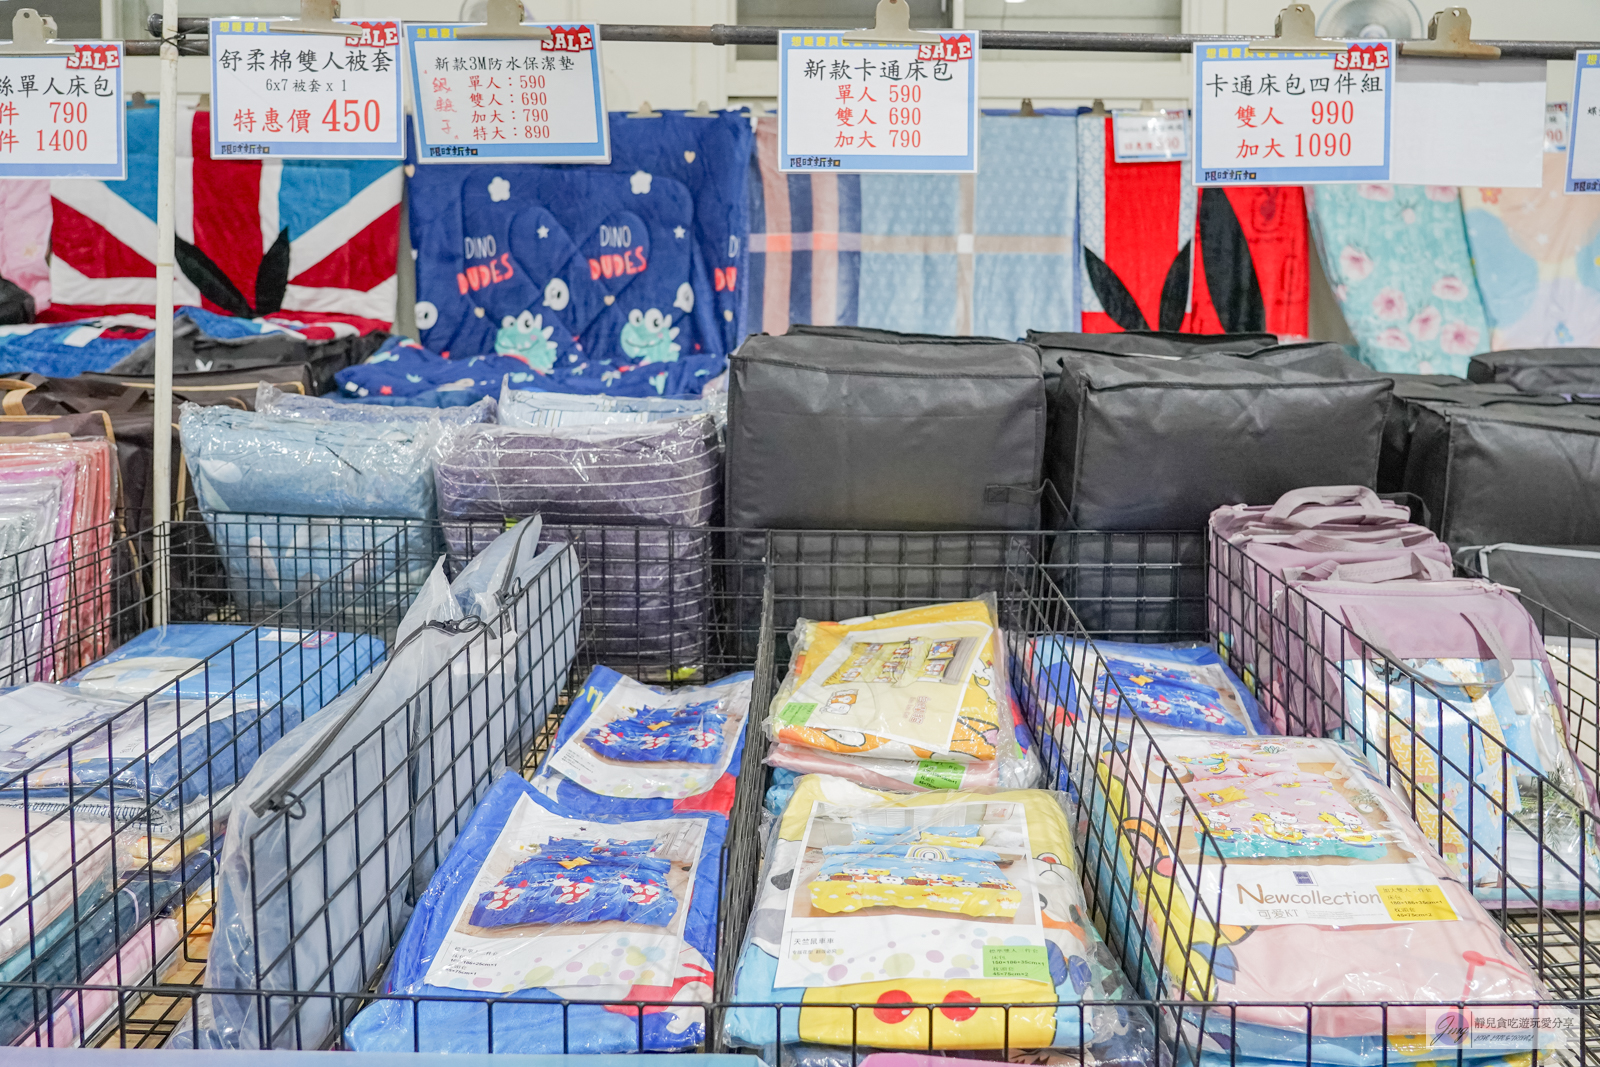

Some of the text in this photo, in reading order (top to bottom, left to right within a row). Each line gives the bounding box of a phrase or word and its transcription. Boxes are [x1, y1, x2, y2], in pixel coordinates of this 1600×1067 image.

[347, 27, 399, 46] SALE
[542, 32, 593, 52] SALE
[67, 50, 119, 69] SALE
[219, 49, 393, 72] 舒柔棉雙人被套
[919, 42, 972, 61] SALE
[1336, 50, 1389, 70] SALE
[434, 56, 575, 72] 新款3M防水保潔墊
[803, 58, 953, 82] 新款卡通床包
[835, 84, 921, 104] 單人 590
[1206, 73, 1383, 97] 卡通床包四件組
[50, 102, 87, 123] 790
[233, 99, 380, 133] 特惠價 450
[835, 107, 921, 127] 雙人 690
[1234, 100, 1354, 128] 雙人 990
[37, 129, 87, 151] 1400
[834, 130, 921, 148] 加大 790
[464, 234, 496, 259] DINO
[600, 225, 631, 248] DINO
[457, 252, 514, 295] DUDES
[589, 246, 647, 280] DUDES
[1237, 883, 1381, 905] Newcollection
